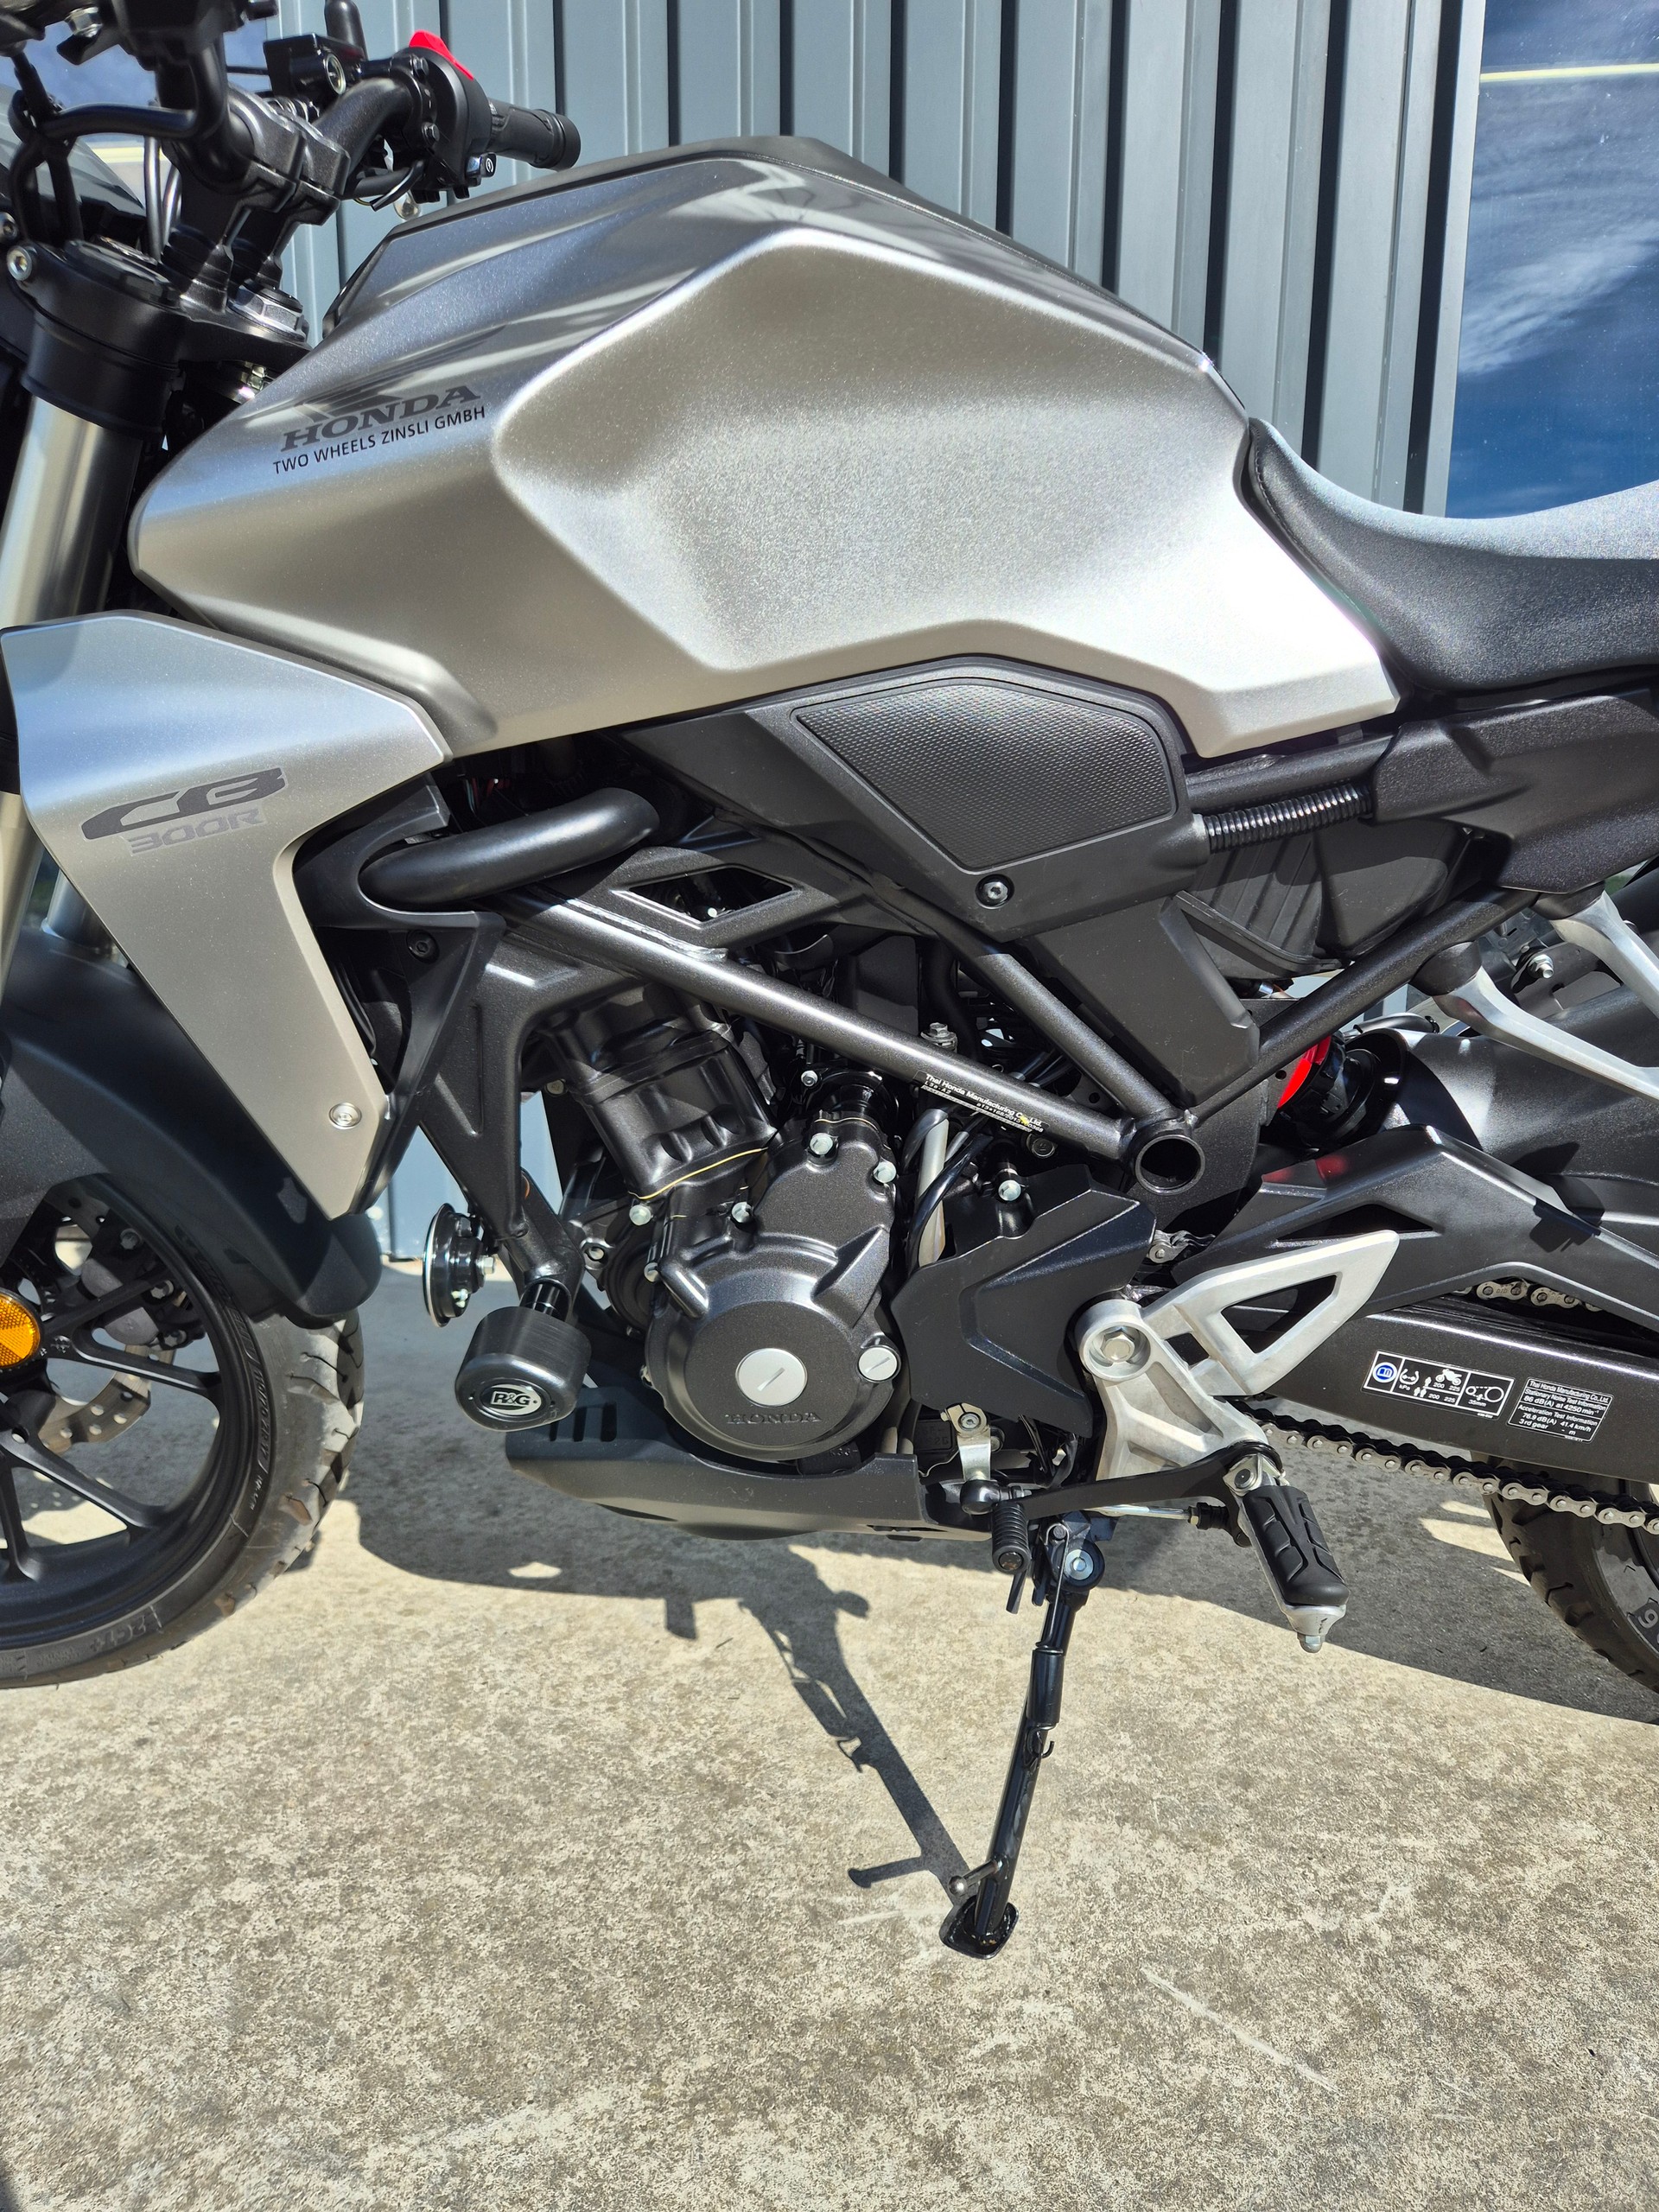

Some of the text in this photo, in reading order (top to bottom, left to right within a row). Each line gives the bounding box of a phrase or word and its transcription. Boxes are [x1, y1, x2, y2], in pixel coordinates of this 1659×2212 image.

[281, 385, 480, 452] HONDA
[273, 406, 486, 474] TWO WHEELS ZINSLI GMBH
[81, 767, 286, 840] CB
[128, 809, 263, 855] 300R
[926, 1073, 942, 1084] Thai
[942, 1081, 966, 1095] Honda
[966, 1090, 1015, 1116] Manufacturing
[492, 1391, 531, 1406] R&G
[1524, 1389, 1551, 1399] Stationary
[1578, 1400, 1606, 1410] Information
[1541, 1382, 1556, 1392] Honda
[1557, 1387, 1590, 1400] Manufacturing
[1518, 1404, 1553, 1416] Acceleration
[1566, 1414, 1598, 1427] Information
[1534, 1397, 1554, 1408] dB(A)
[1564, 1403, 1581, 1413] 4250
[724, 1413, 823, 1425] HONDA
[1537, 1414, 1557, 1425] dB(A)
[1574, 1424, 1592, 1433] km/h
